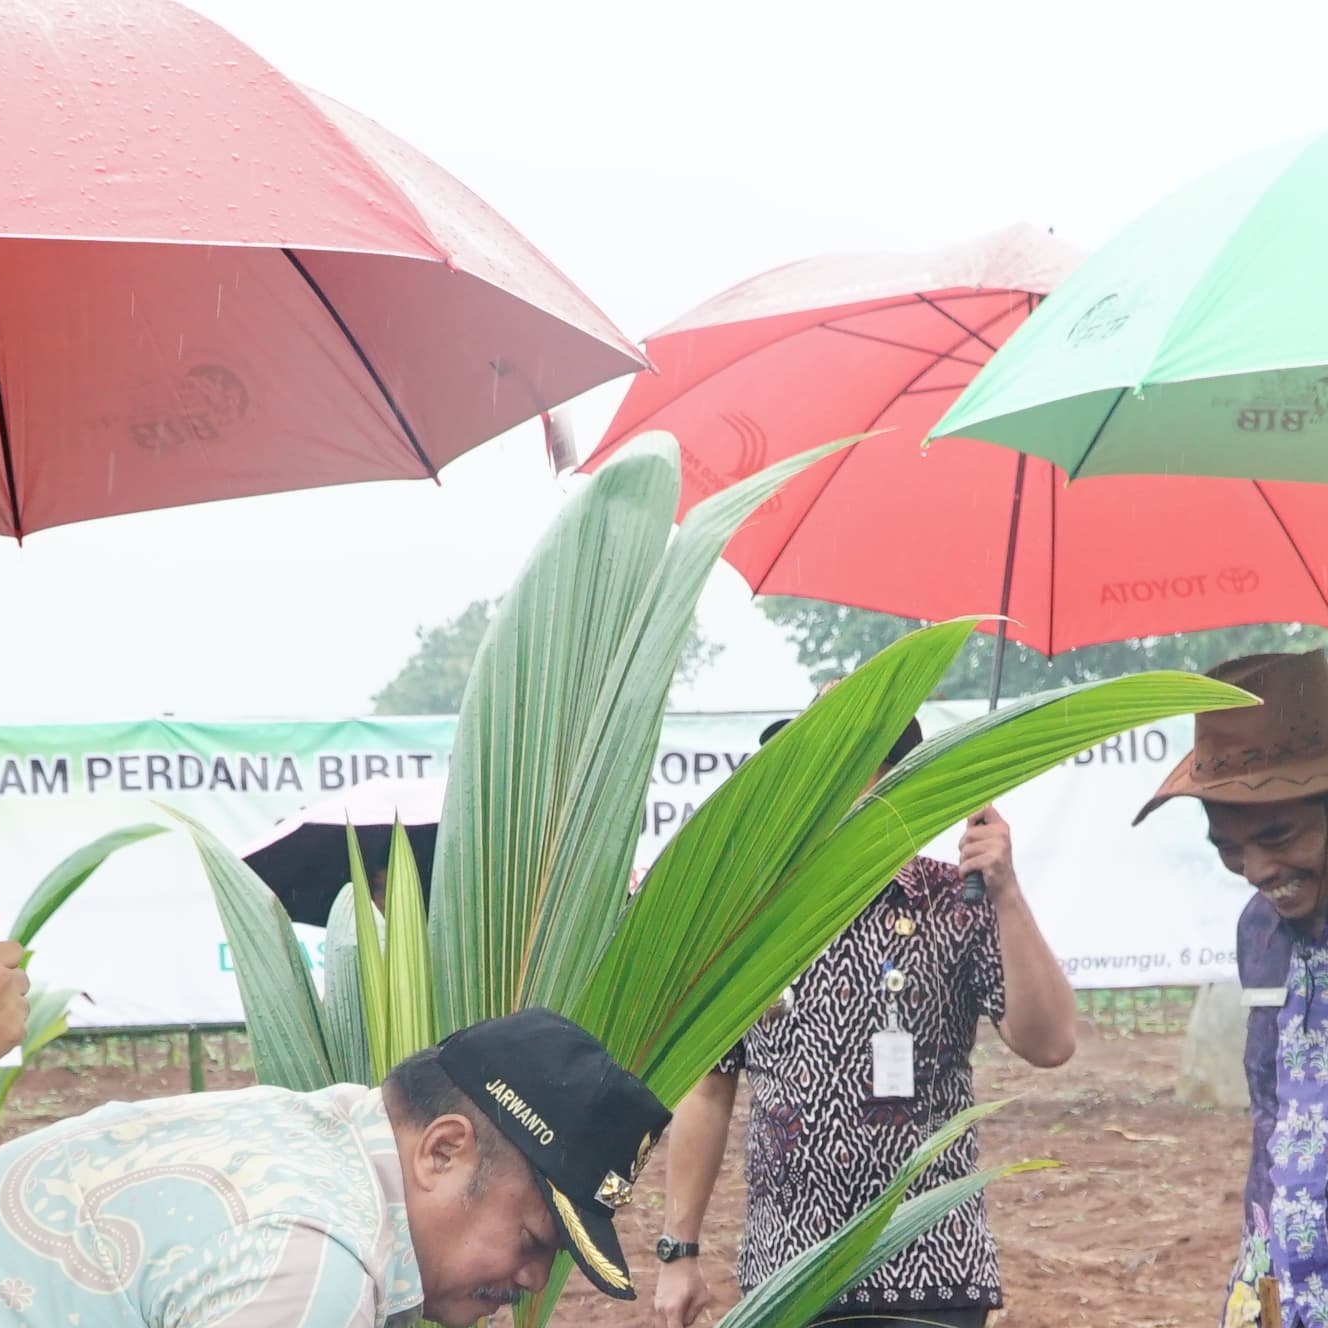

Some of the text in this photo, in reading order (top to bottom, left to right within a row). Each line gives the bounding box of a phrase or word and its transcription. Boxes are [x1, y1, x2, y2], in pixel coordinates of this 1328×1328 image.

[87, 754, 303, 793] PERDANA
[651, 752, 750, 785] OPY
[1062, 729, 1168, 766] BRIO
[1056, 954, 1172, 976] ogowungu,
[1180, 950, 1192, 967] 6
[485, 1078, 555, 1146] JARWANTO
